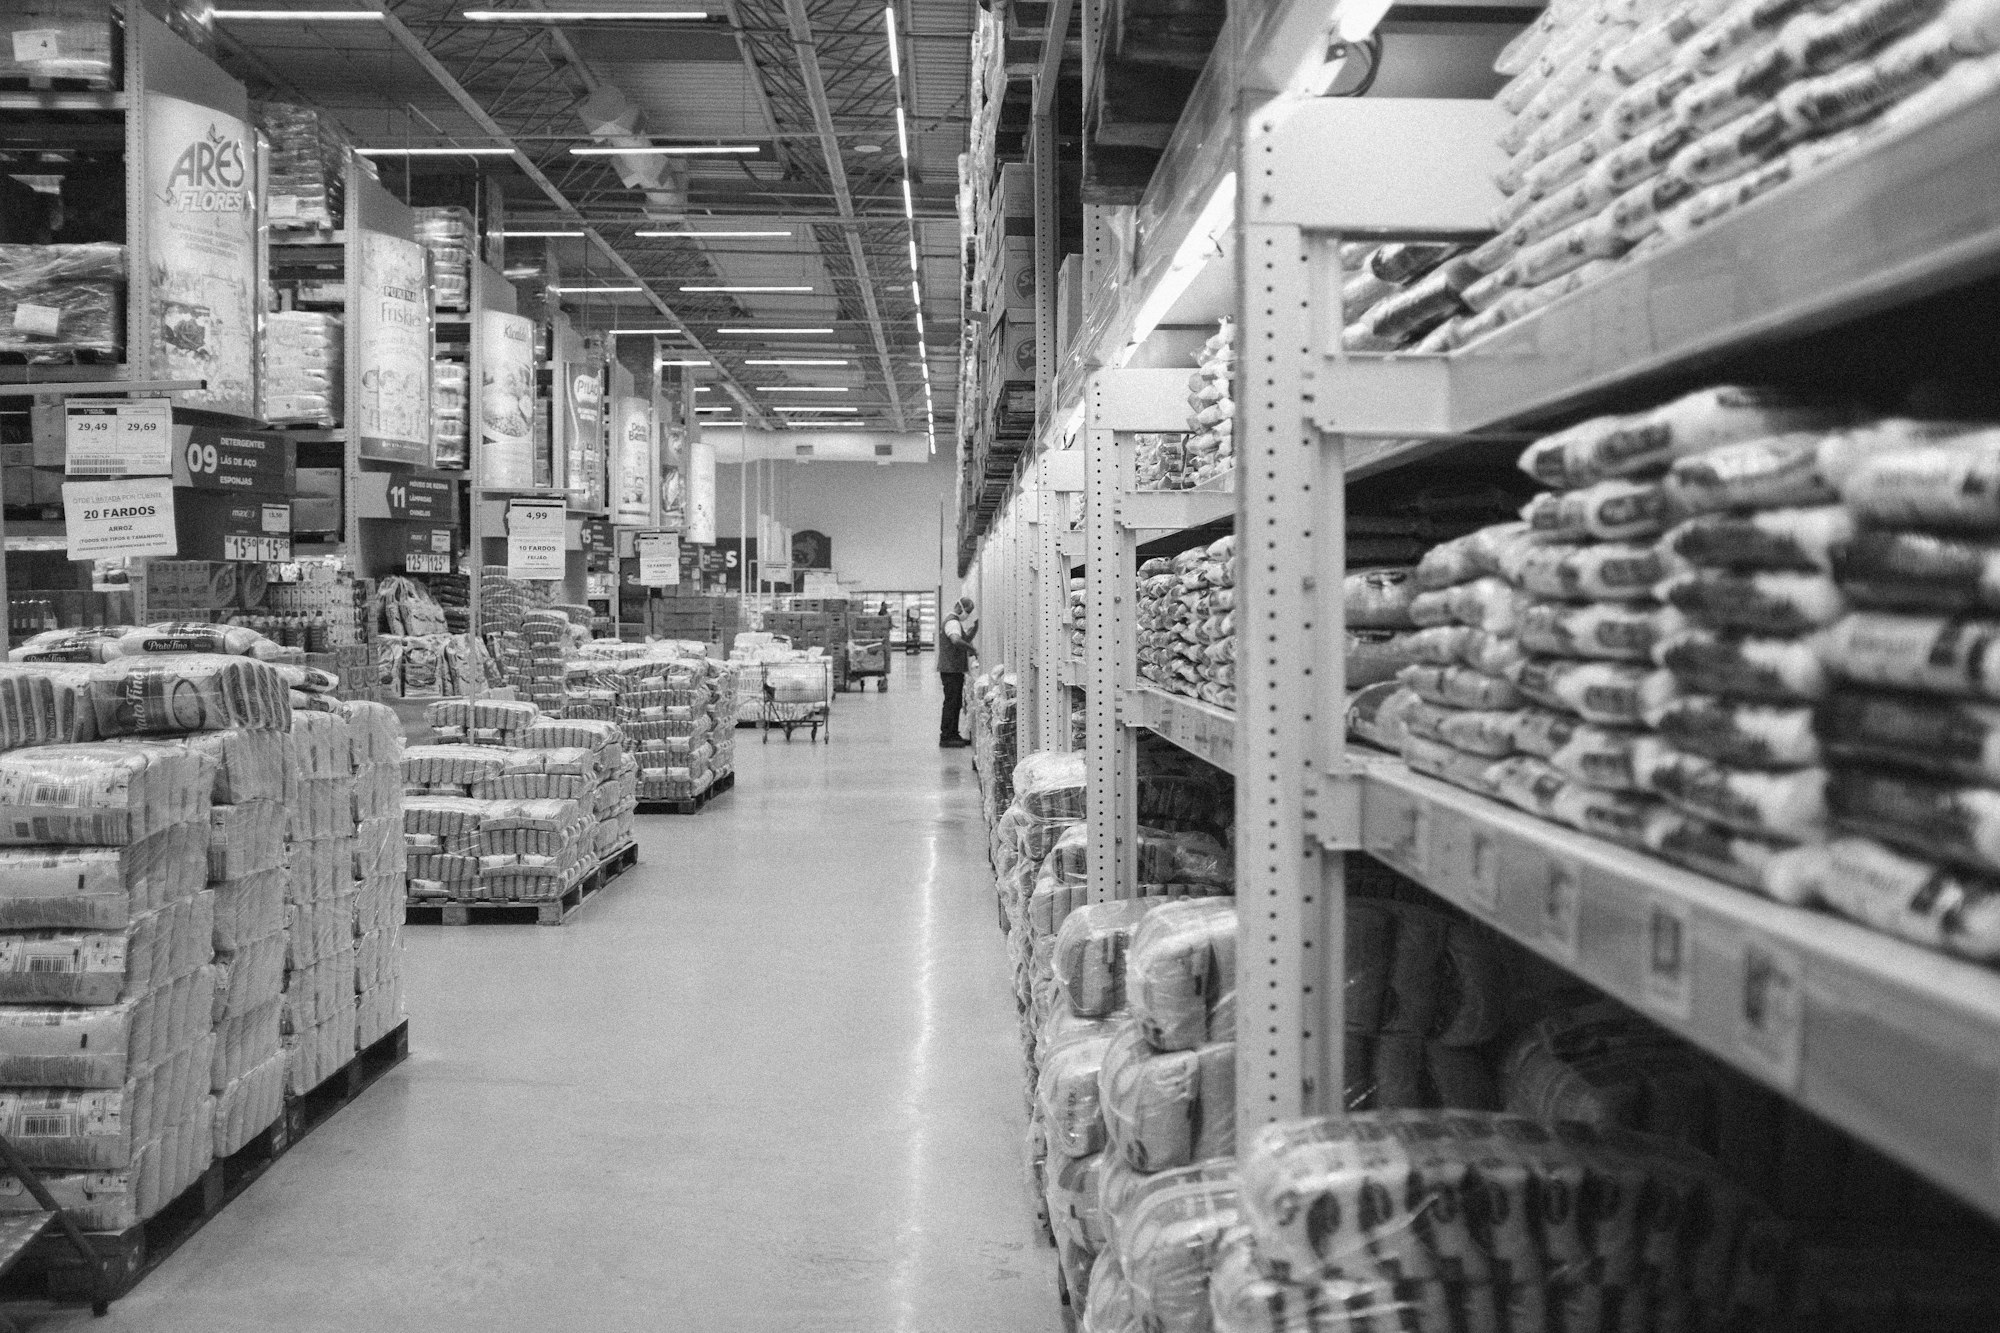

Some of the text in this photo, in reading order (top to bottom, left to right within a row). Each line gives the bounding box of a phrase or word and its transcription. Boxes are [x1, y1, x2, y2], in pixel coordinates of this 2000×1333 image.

[177, 190, 243, 213] FLORES
[78, 422, 108, 433] 29,49
[127, 422, 157, 433] 29,69
[220, 437, 266, 449] DETERGENTES
[187, 442, 218, 474] 09
[233, 457, 243, 466] DE
[220, 475, 253, 485] ESPONJAS
[137, 492, 162, 500] CLIENTE
[390, 486, 406, 508] 11
[83, 505, 156, 520] 20 FARDOS
[526, 512, 548, 520] 4,99
[233, 538, 246, 558] 15
[266, 539, 279, 560] 15
[147, 640, 171, 650] Prato
[170, 640, 188, 650] Fino
